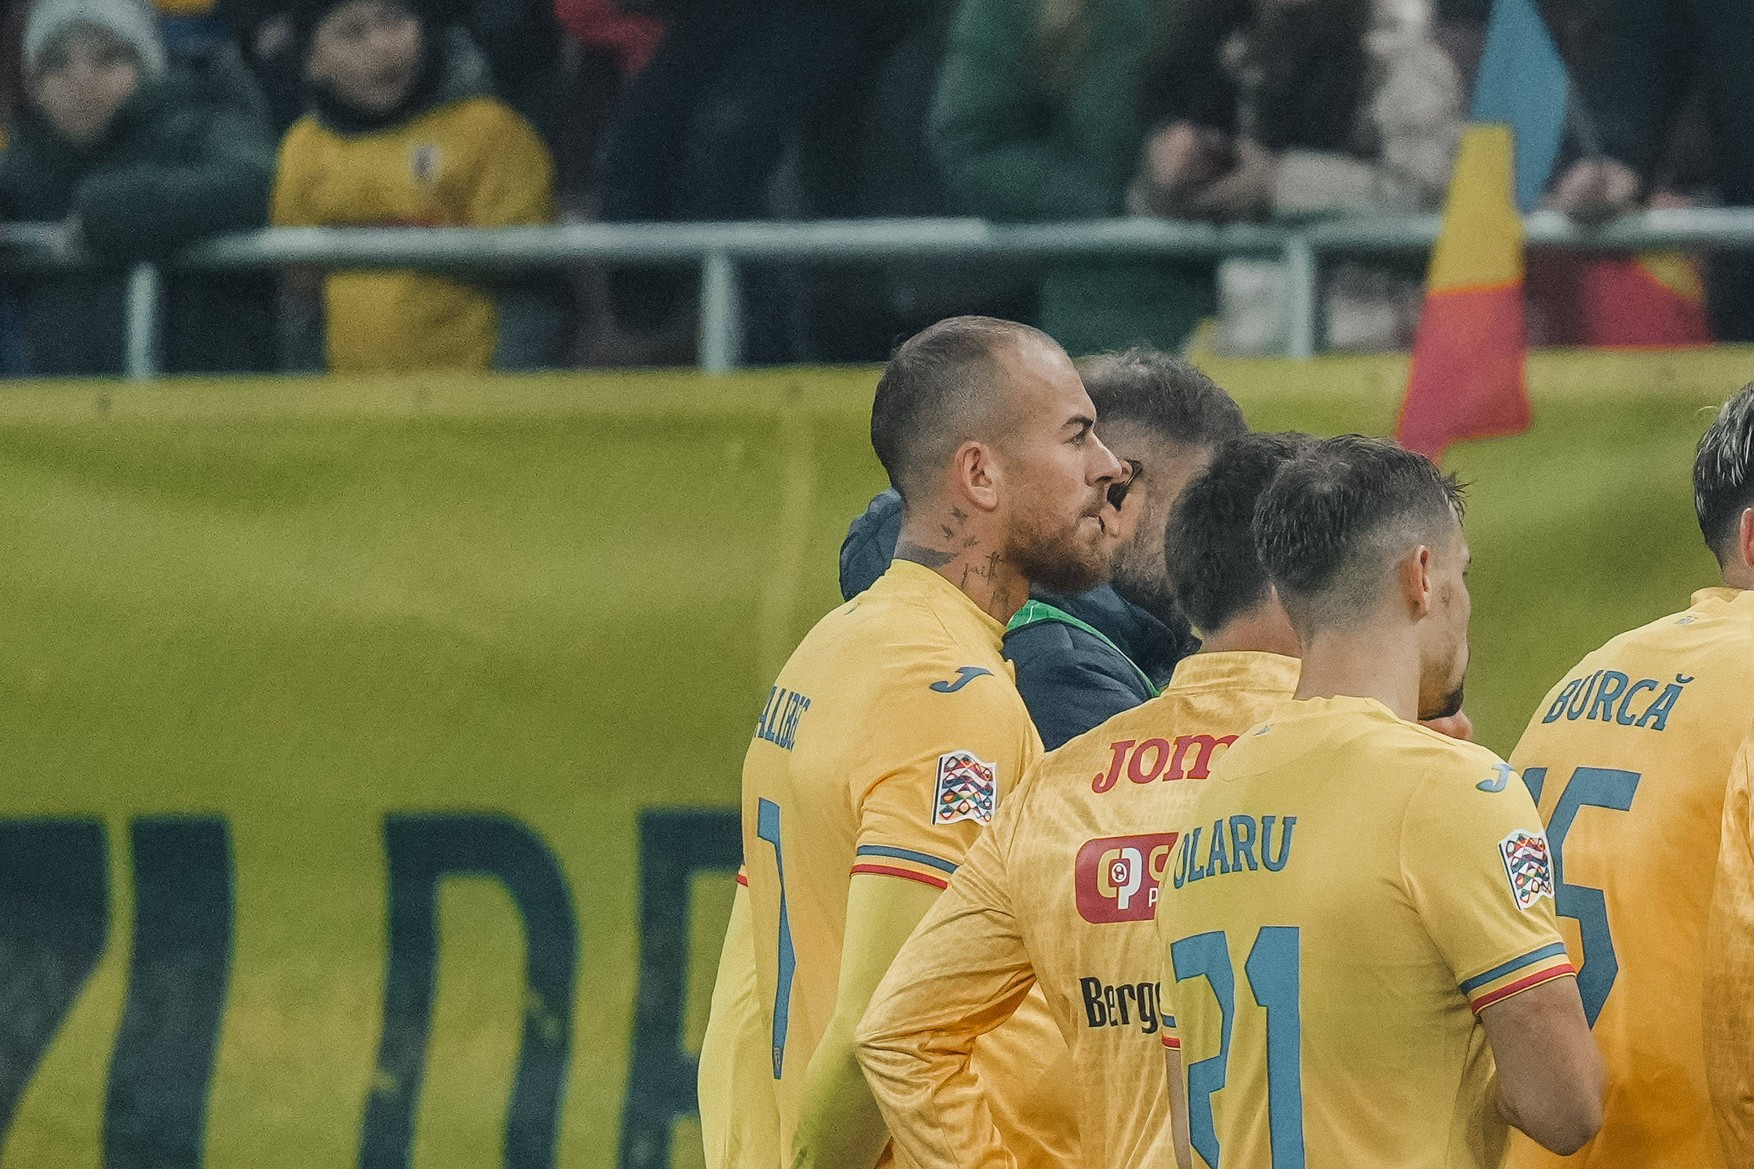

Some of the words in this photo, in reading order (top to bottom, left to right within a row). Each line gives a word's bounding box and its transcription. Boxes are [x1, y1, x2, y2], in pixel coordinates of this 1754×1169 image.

[1541, 669, 1695, 732] BURCĂ
[1172, 814, 1298, 890] OLARU
[1522, 766, 1642, 1031] 5
